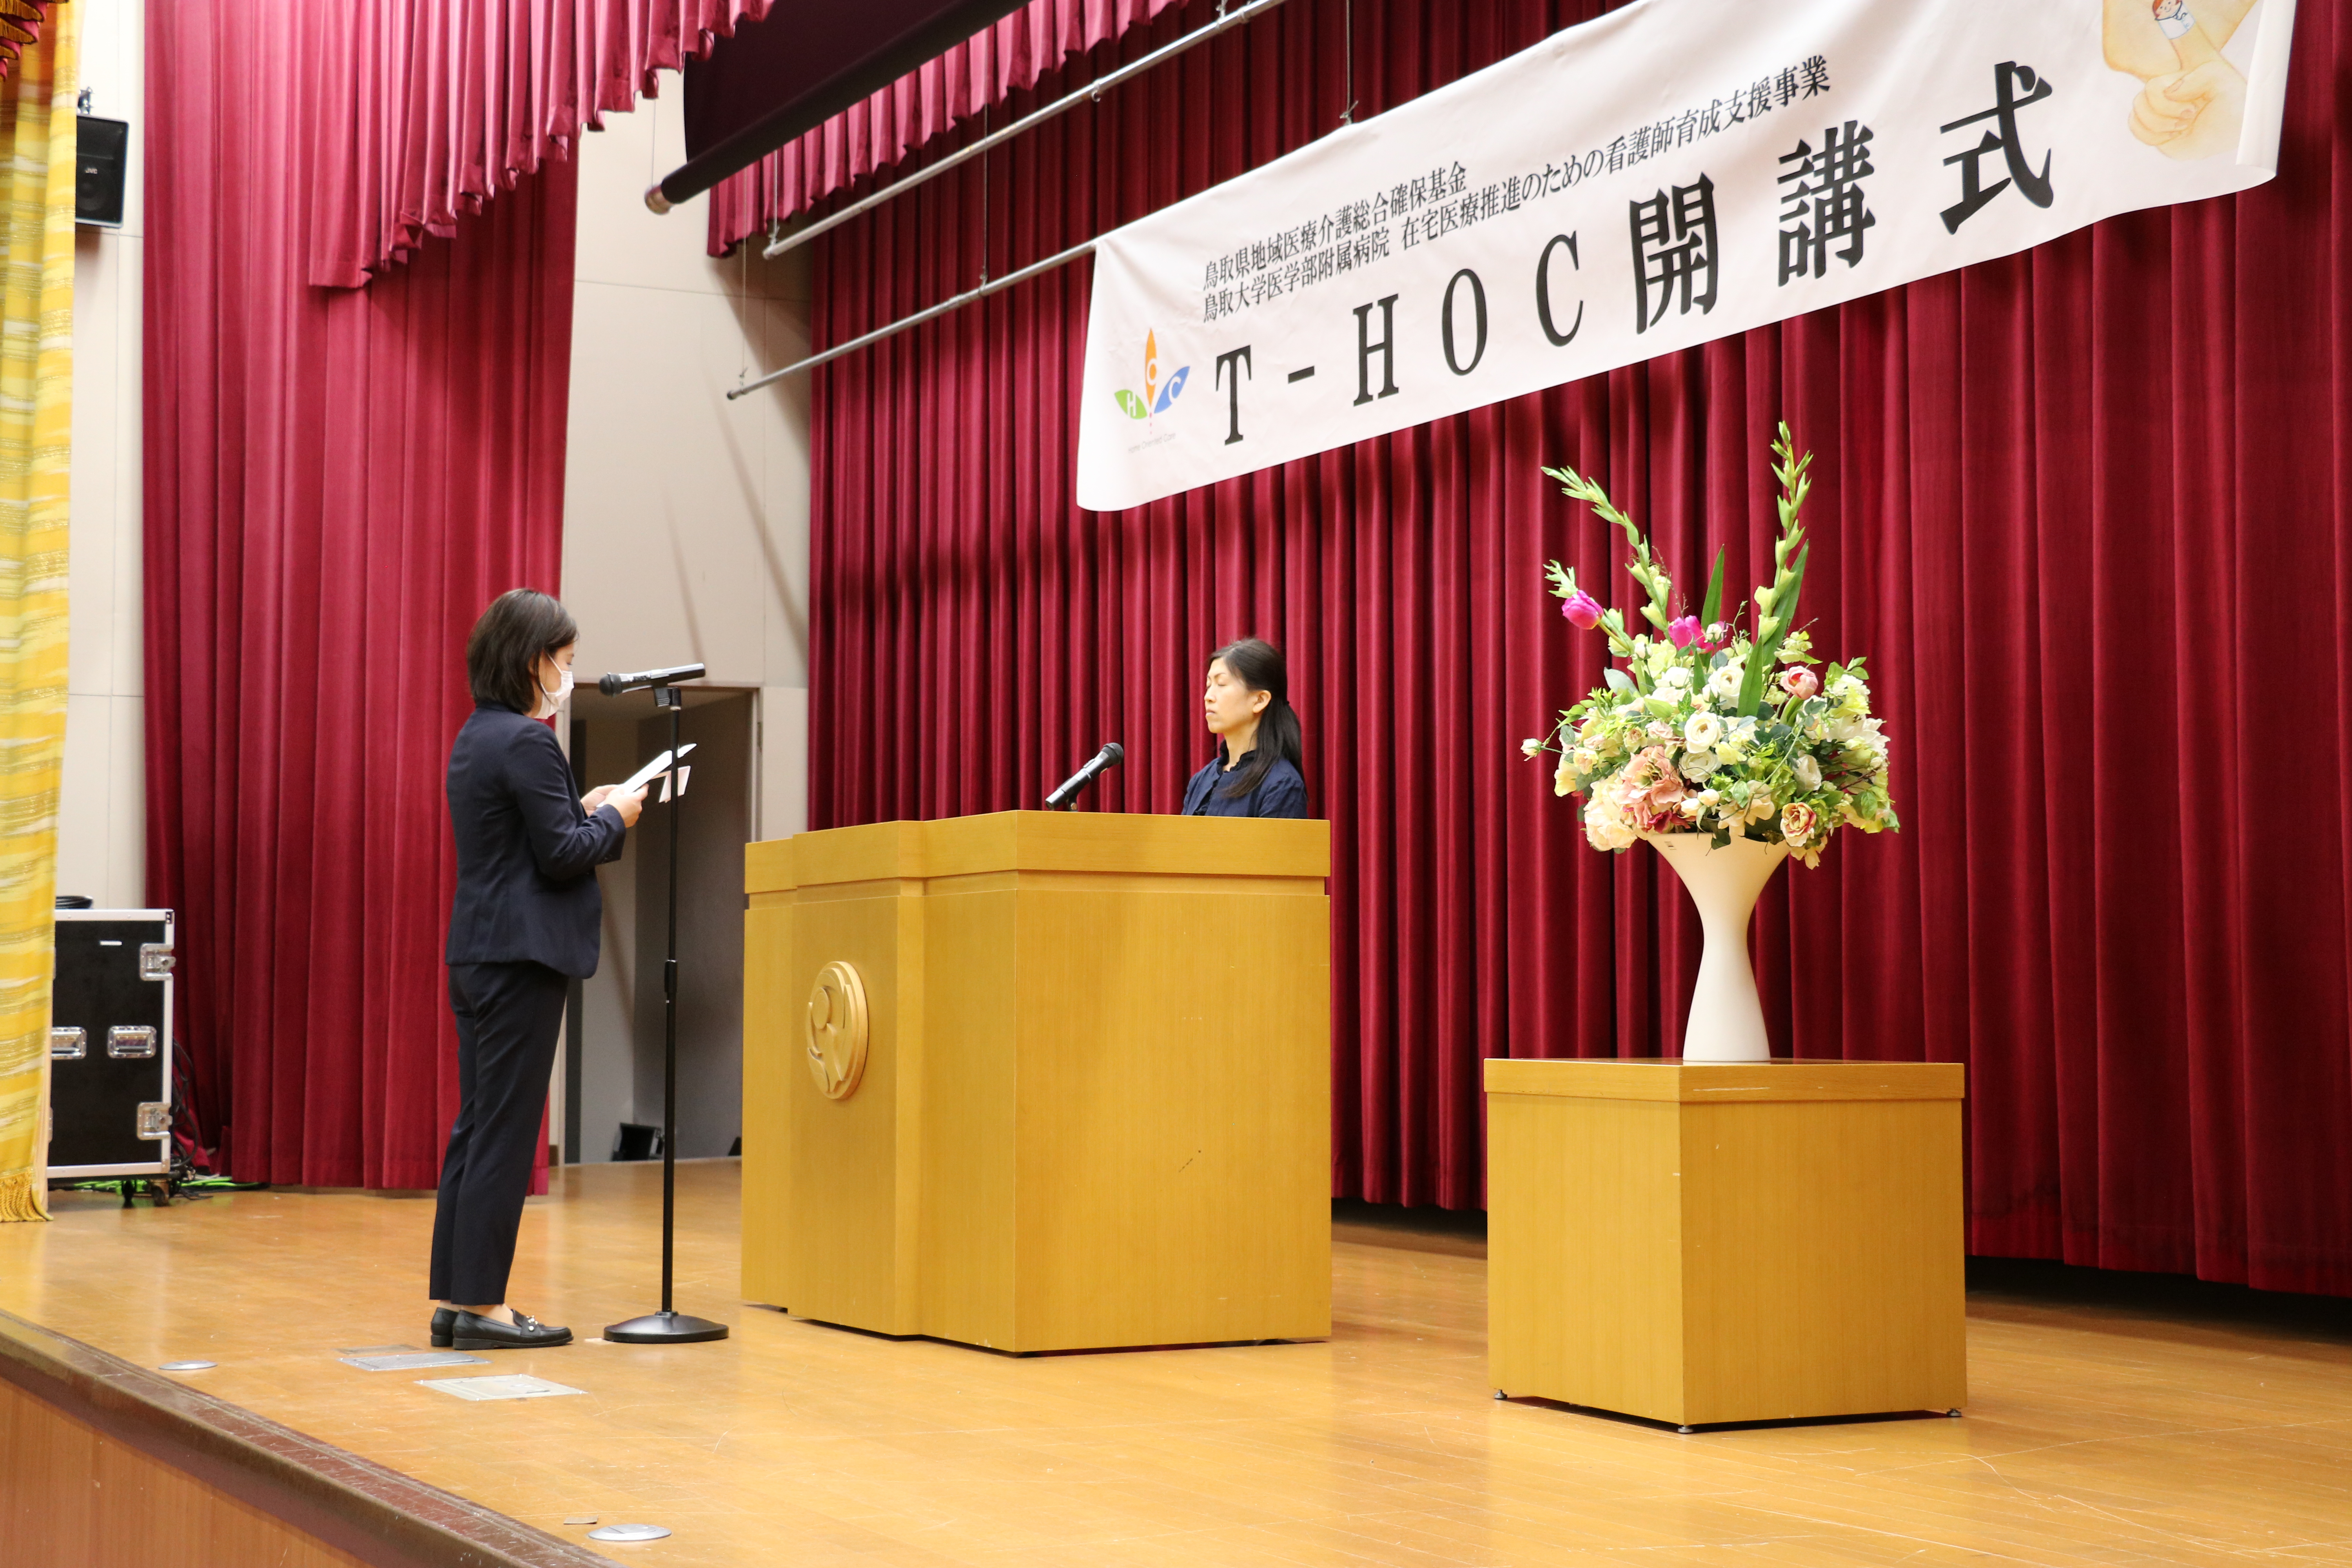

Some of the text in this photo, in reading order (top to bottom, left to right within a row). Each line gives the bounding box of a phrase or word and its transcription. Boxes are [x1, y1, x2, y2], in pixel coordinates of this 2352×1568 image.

[1203, 54, 1831, 323] 鳥取大学医学部附属病院 在宅医療推進のための看護師育成支援事業
[1203, 161, 1466, 290] 鳥取県地域医療介護総合確保基金
